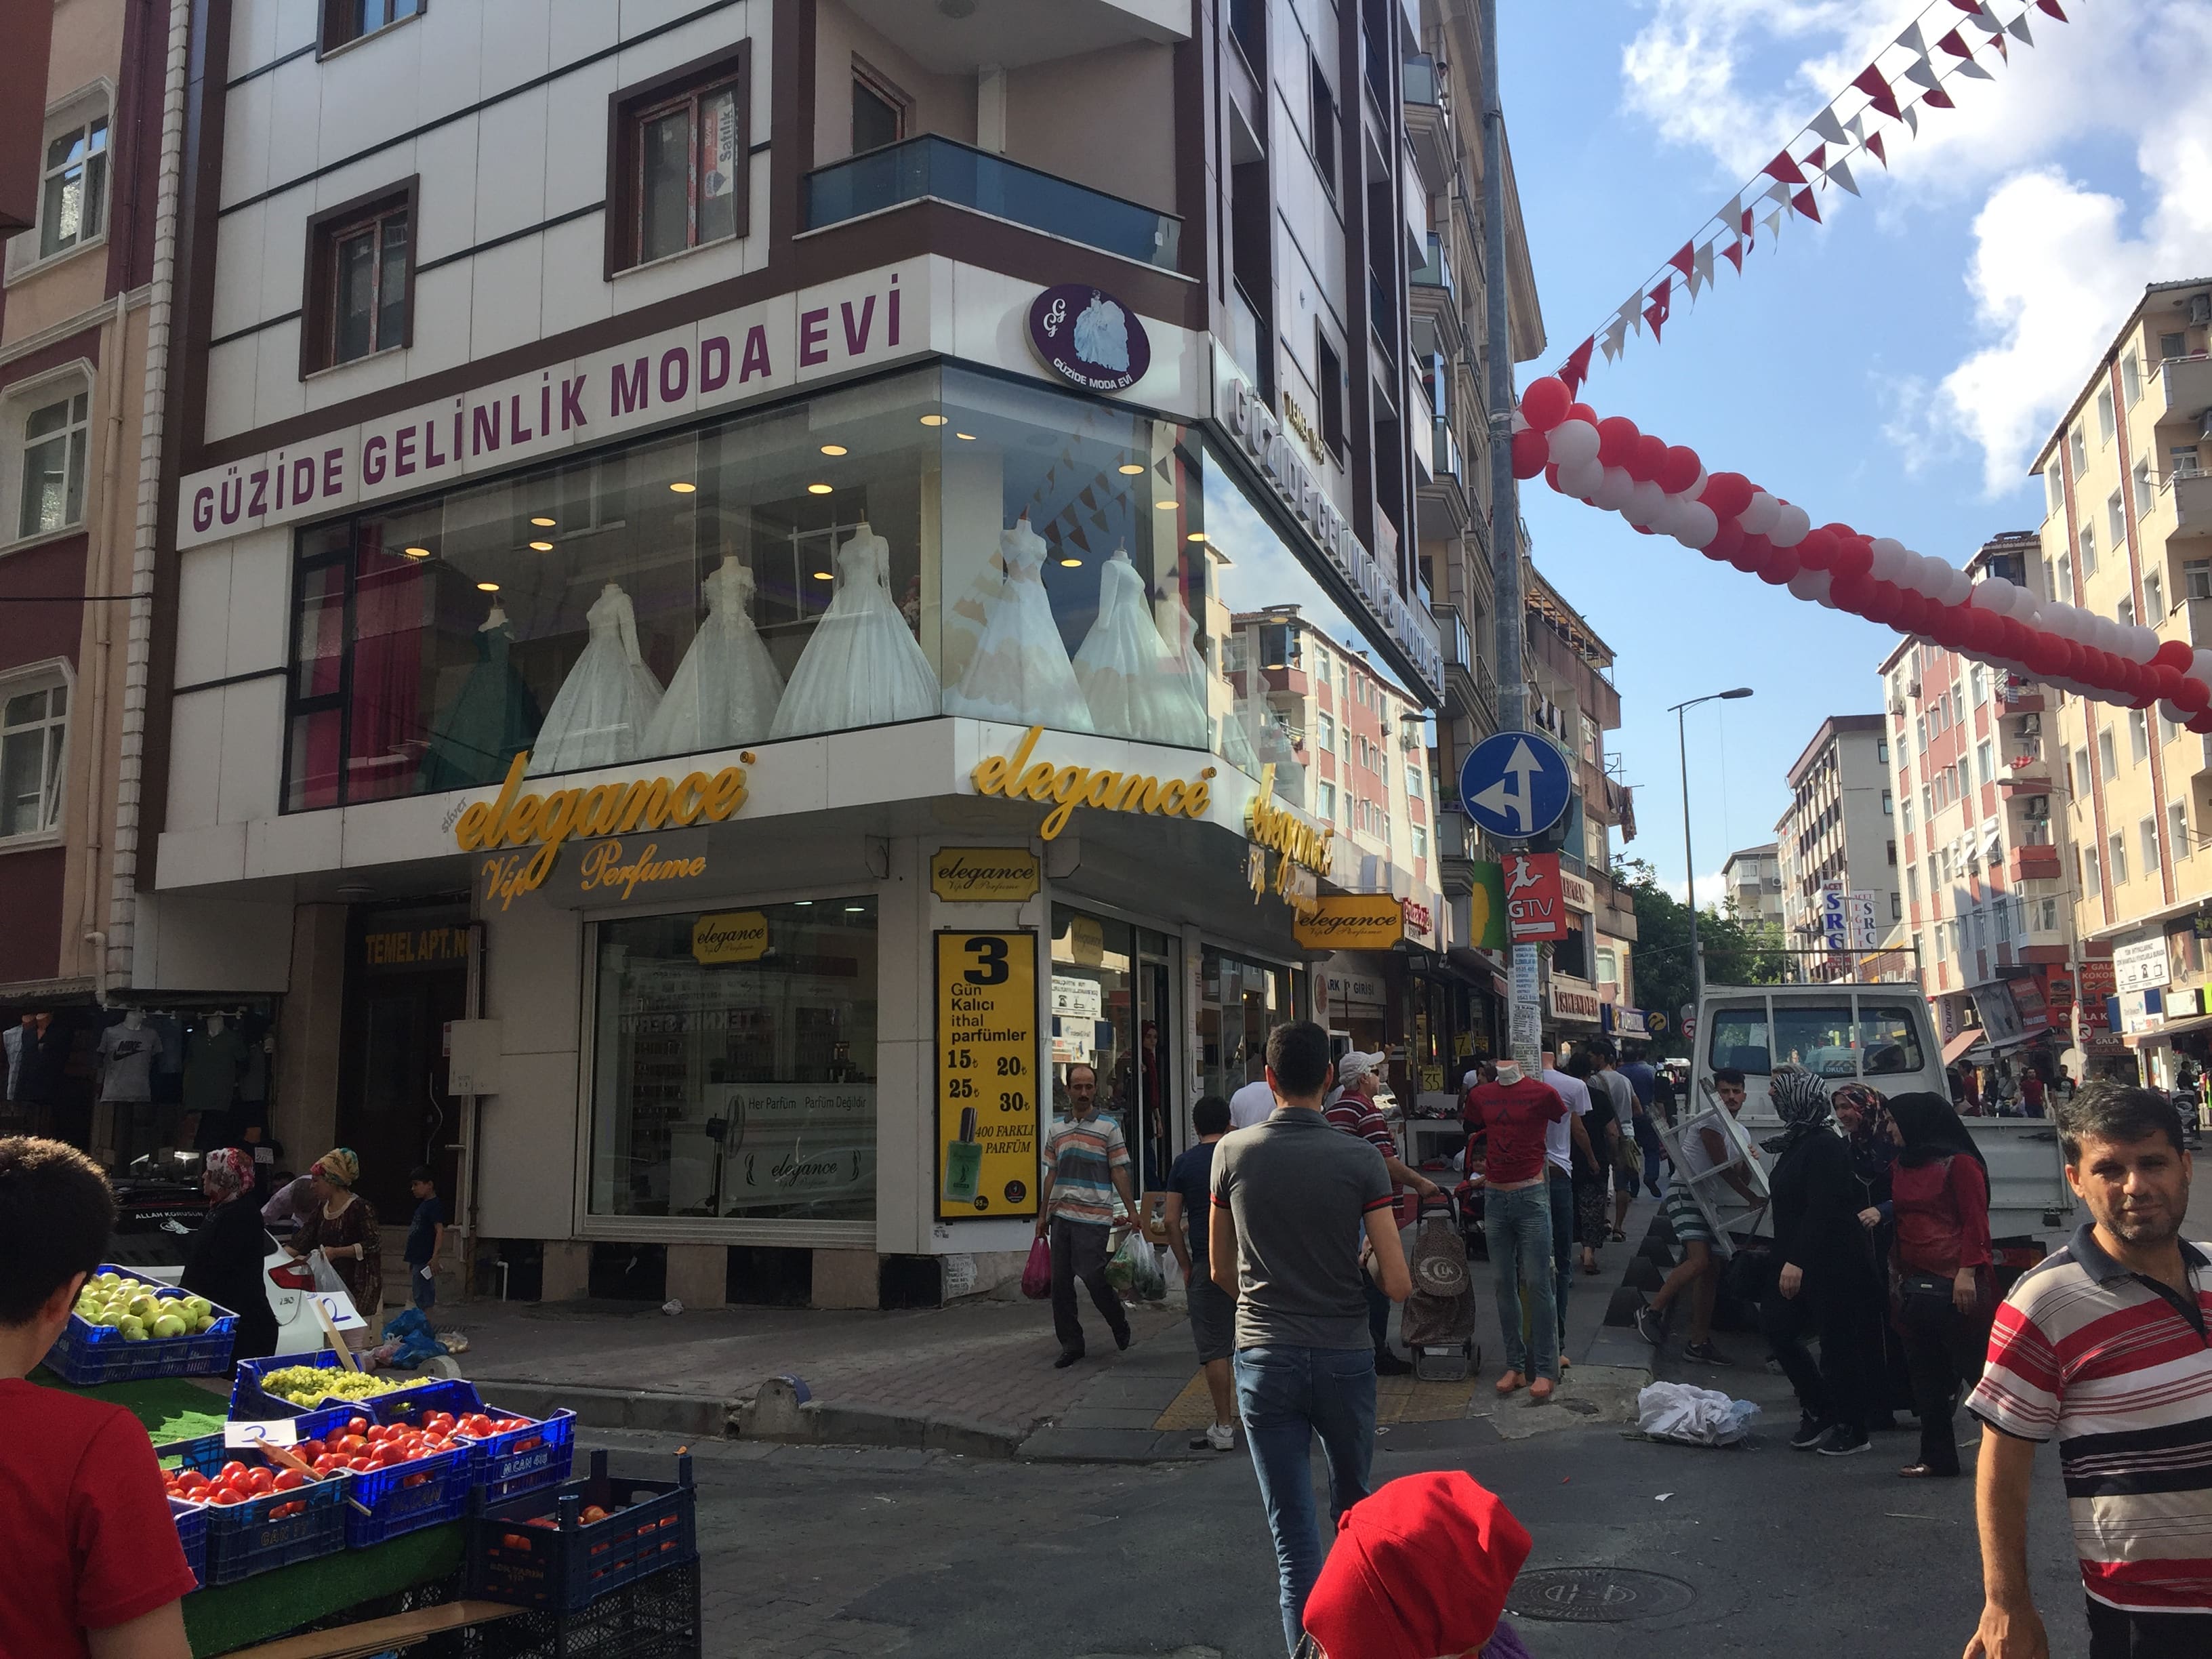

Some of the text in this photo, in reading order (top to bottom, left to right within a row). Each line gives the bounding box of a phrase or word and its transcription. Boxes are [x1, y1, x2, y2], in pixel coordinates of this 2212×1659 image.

[1053, 357, 1133, 390] GÜZİDE MODA EVİ
[193, 273, 901, 533] GÜZİDE GELİNLİK MODA EVİ
[970, 725, 1211, 841] elegance
[455, 750, 749, 890] elegance
[581, 838, 706, 900] Perfume
[939, 857, 1034, 890] elegance
[1823, 882, 1843, 891] ACET
[1508, 898, 1553, 918] GTV
[1298, 908, 1397, 935] elegance
[365, 931, 414, 964] TEMEL
[697, 922, 764, 952] elegance
[964, 937, 1009, 985] 3
[951, 983, 982, 996] Gün
[1554, 985, 1599, 1017] İSKENDER
[951, 998, 994, 1011] Kalıcı
[1946, 998, 1954, 1034] Onurair
[951, 1014, 984, 1027] ithal
[951, 1029, 1027, 1045] parfümler
[1423, 1073, 1441, 1091] 35
[749, 1097, 764, 1110] Her
[766, 1097, 796, 1110] Parfüm
[804, 1096, 834, 1109] Parfüm
[975, 1124, 1035, 1138] 400 FARKLI
[985, 1139, 1031, 1154] PARFÜM
[771, 1153, 838, 1187] elegance
[136, 1210, 204, 1220] ALLAH KORUSUN
[322, 1297, 352, 1323] 2
[241, 1425, 279, 1443] 2
